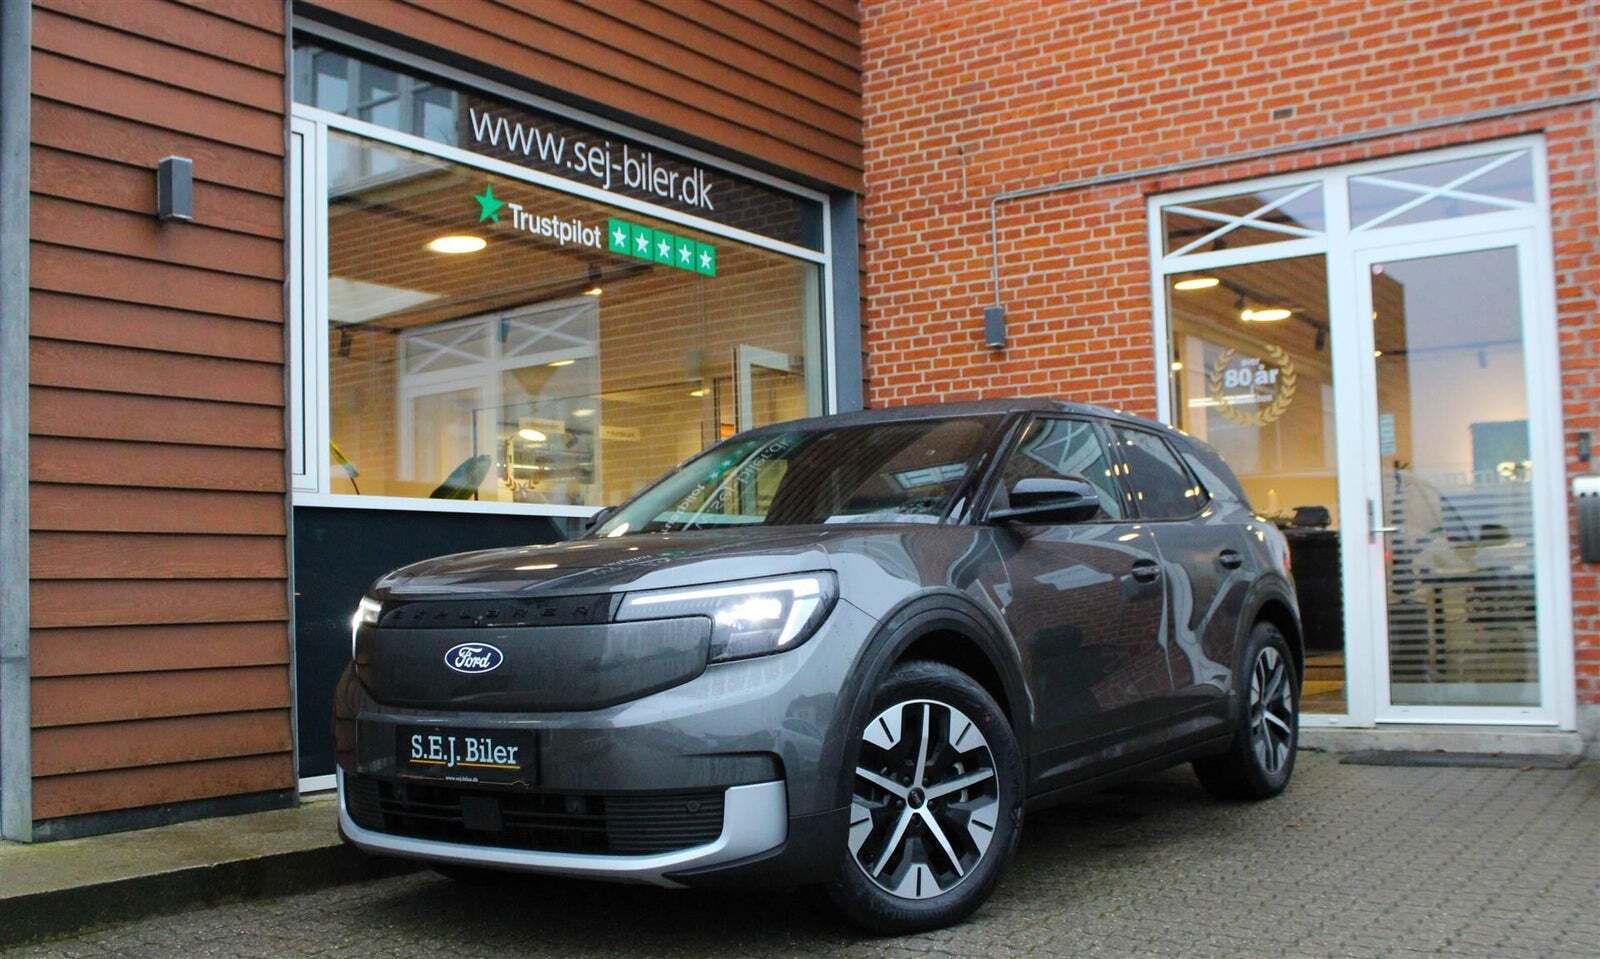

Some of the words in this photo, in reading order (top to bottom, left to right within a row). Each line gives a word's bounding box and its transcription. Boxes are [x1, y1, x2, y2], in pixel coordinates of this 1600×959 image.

[469, 107, 715, 211] www.sej-biler.dk
[508, 203, 602, 249] Trustpilot
[1224, 368, 1252, 388] 80
[1255, 364, 1279, 385] år
[454, 646, 492, 669] Ford
[411, 734, 461, 767] S.E.J.
[465, 737, 519, 764] Biler
